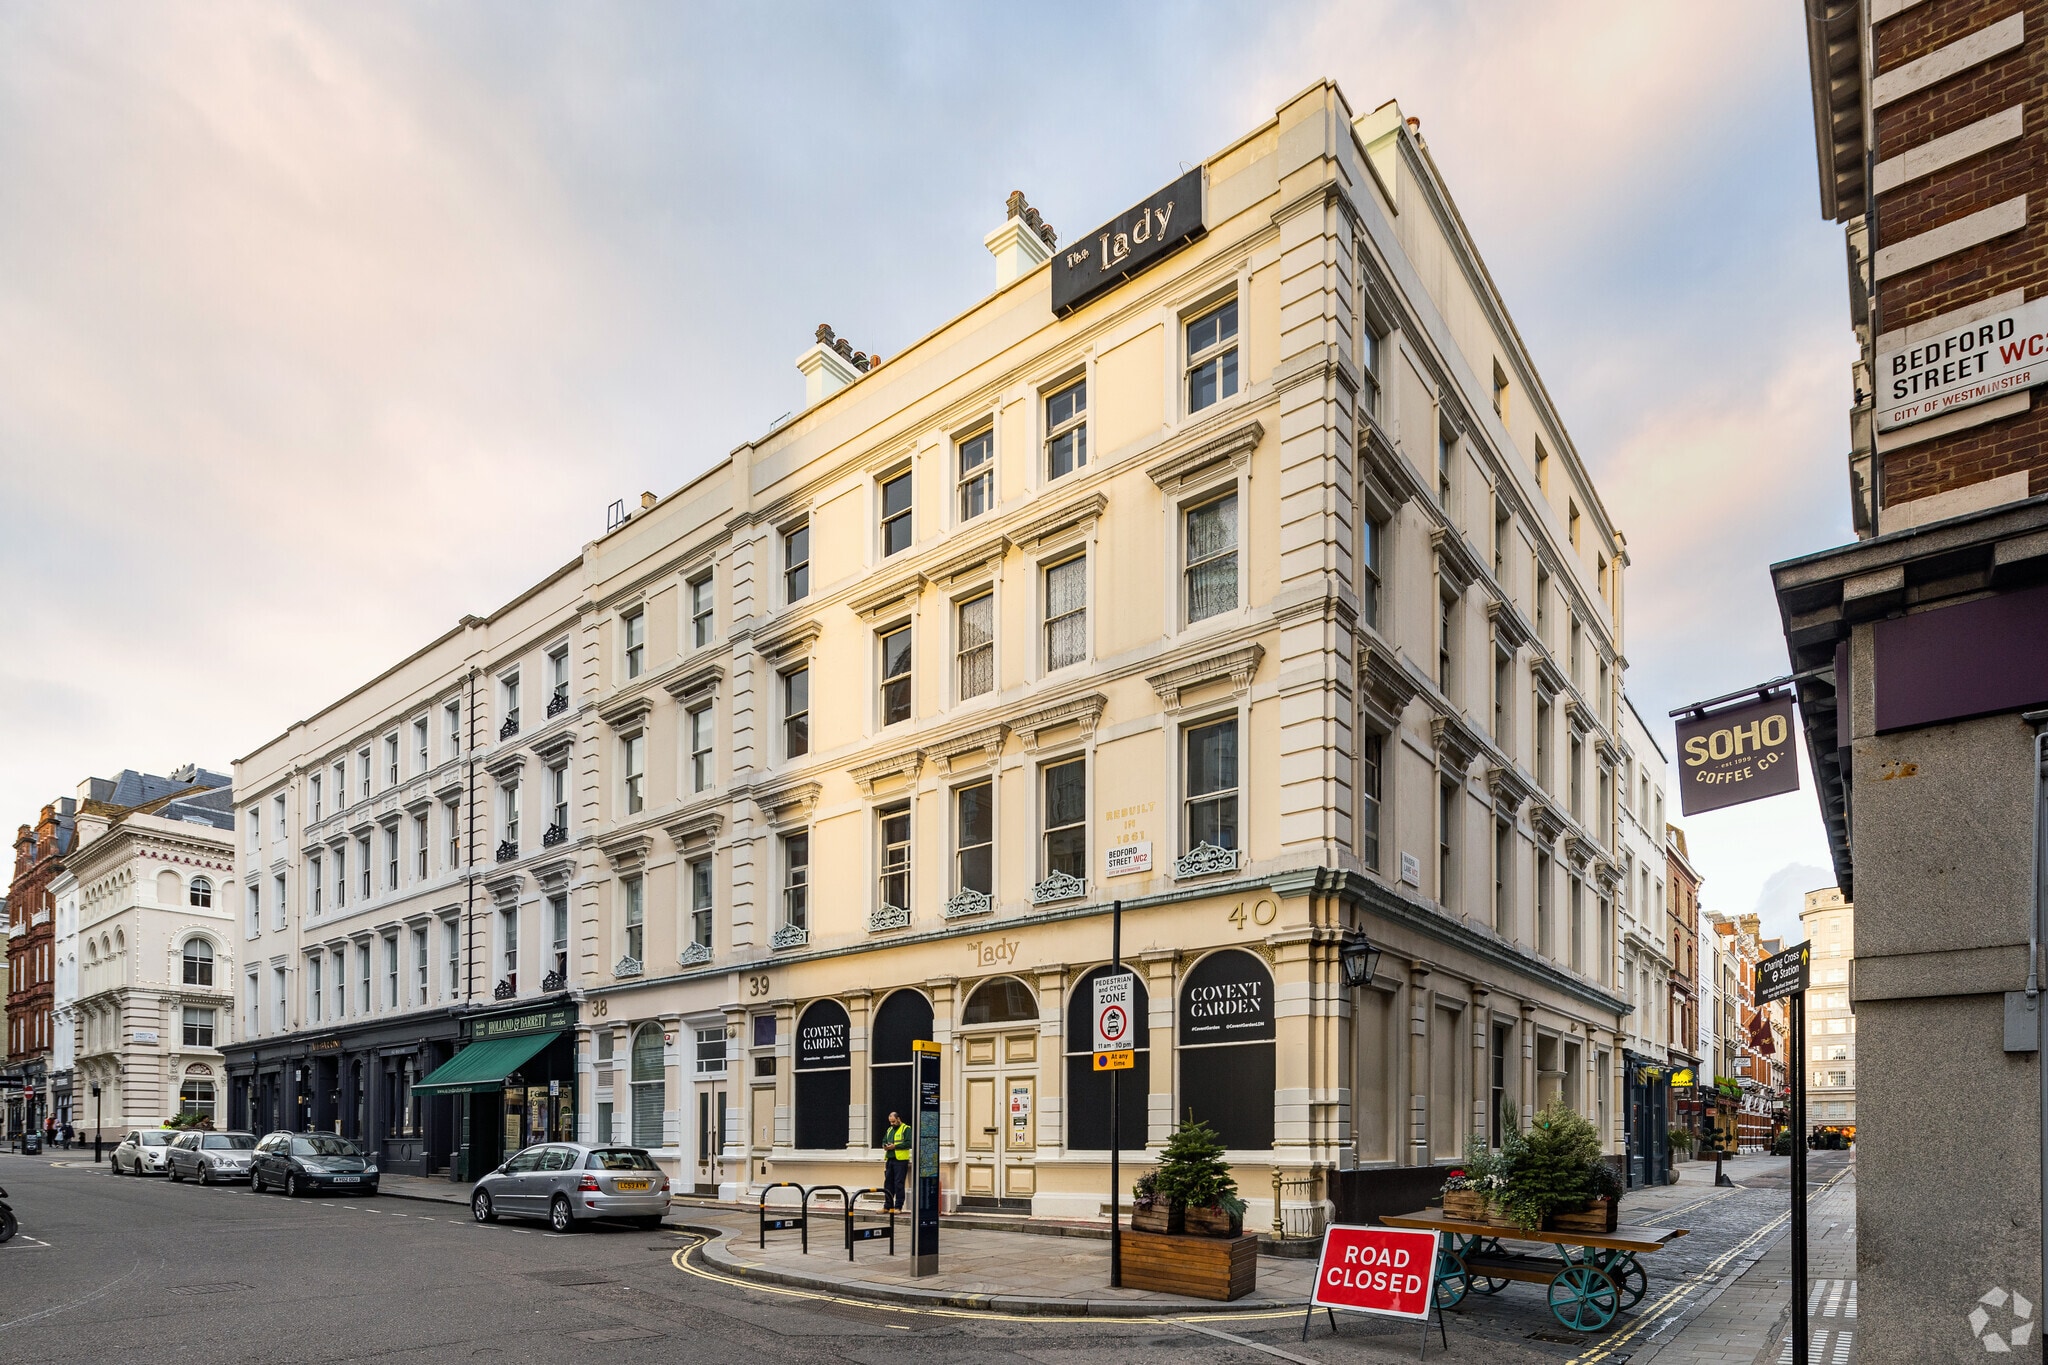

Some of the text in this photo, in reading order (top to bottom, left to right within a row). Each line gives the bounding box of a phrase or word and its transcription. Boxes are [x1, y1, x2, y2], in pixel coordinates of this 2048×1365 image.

[1065, 201, 1175, 272] The Lady
[1892, 317, 2014, 376] BEDFORD
[1893, 333, 2048, 400] STREET WC
[1894, 371, 2031, 422] CITY OF WESTMINSTER
[1684, 714, 1788, 767] SOHO
[1720, 755, 1752, 769] est 1999
[1695, 766, 1754, 785] COFFEE
[1106, 802, 1155, 820] REBUILT
[1124, 820, 1135, 829] IN
[1109, 847, 1137, 859] BEDFORD
[1109, 854, 1147, 867] STREET WC2
[1227, 898, 1277, 930] 40
[966, 937, 1020, 968] The Lady
[1764, 952, 1799, 972] Charing Cross
[1096, 976, 1131, 986] PEDESTRIAN
[1780, 965, 1799, 978] Station
[749, 974, 770, 997] 39
[1110, 983, 1127, 992] CYCLE
[1190, 981, 1262, 1002] COVENT
[1101, 992, 1126, 1004] ZONE
[1190, 997, 1262, 1017] GARDEN
[591, 999, 608, 1018] 38
[488, 1013, 547, 1035] HOLLAND & BARRETT
[803, 1024, 844, 1038] COVENT
[803, 1036, 844, 1050] GARDEN
[1344, 1245, 1410, 1268] ROAD
[1326, 1267, 1422, 1294] CLOSED
